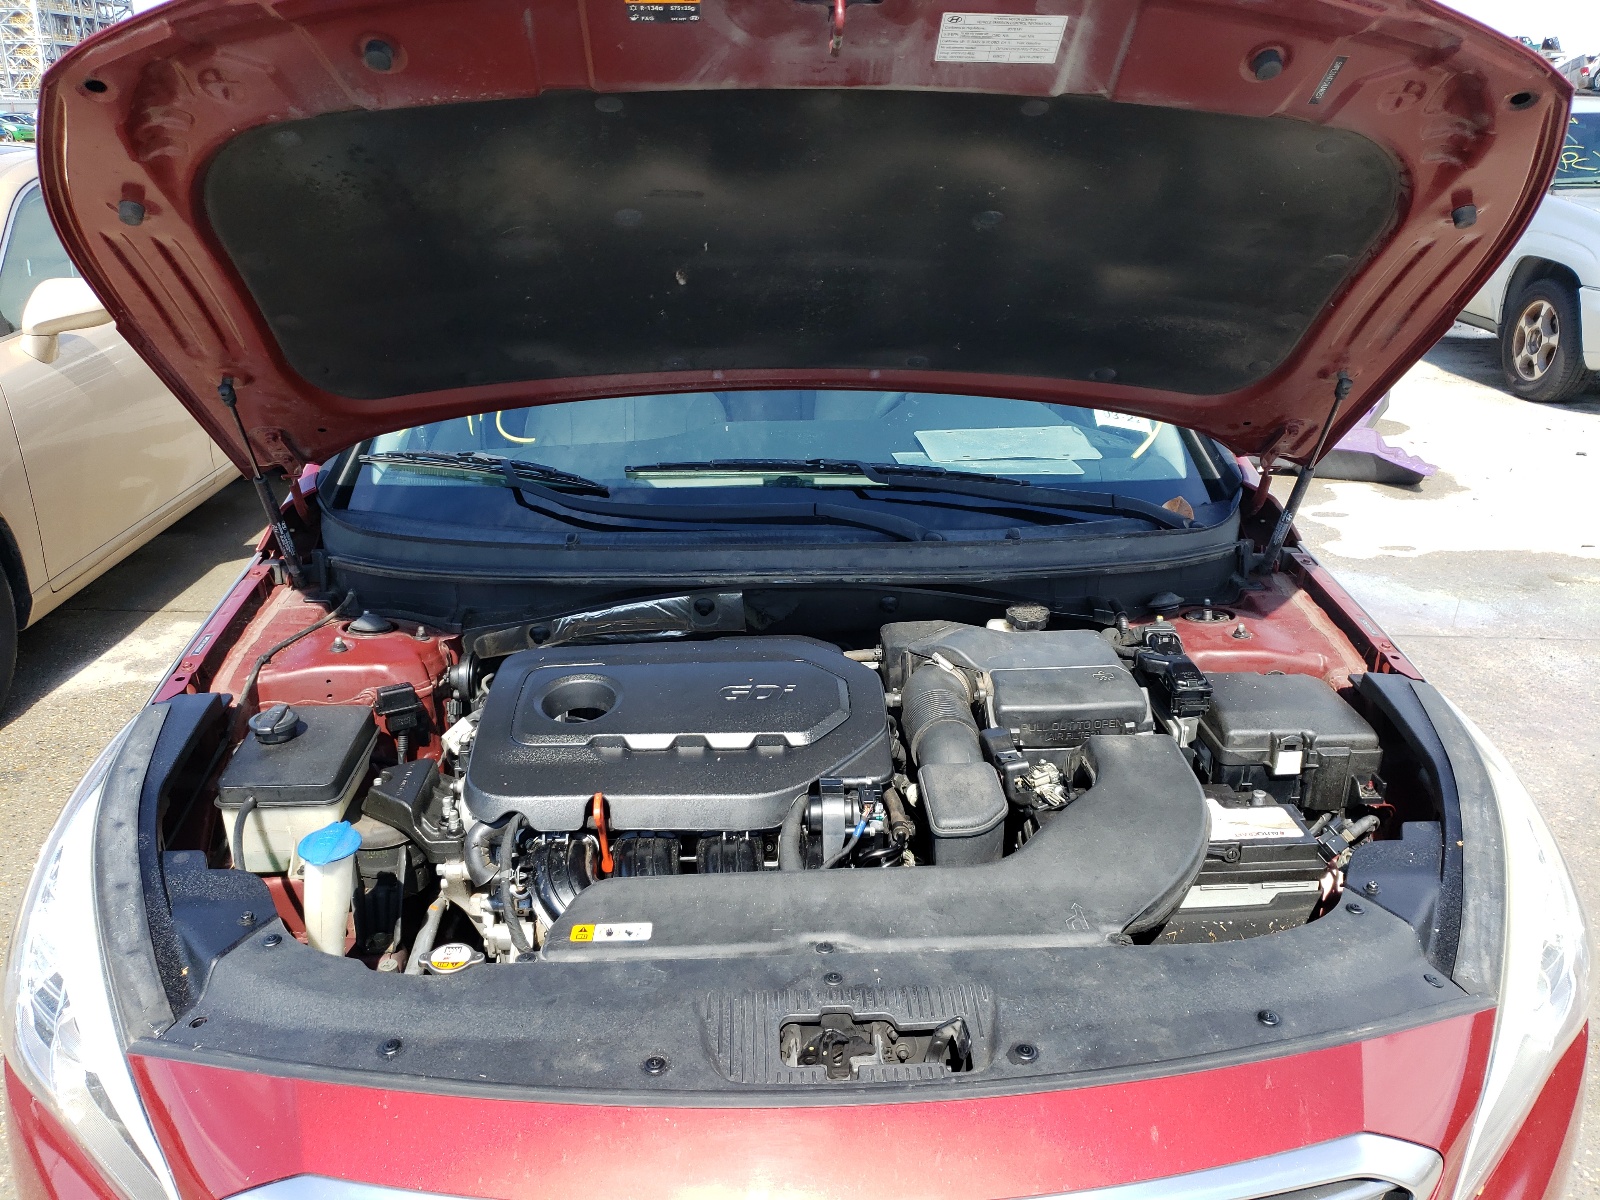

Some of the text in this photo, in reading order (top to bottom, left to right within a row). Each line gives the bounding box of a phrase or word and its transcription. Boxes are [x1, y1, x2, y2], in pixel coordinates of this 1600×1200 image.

[1020, 719, 1123, 732] PULL OUT TO OPEN
